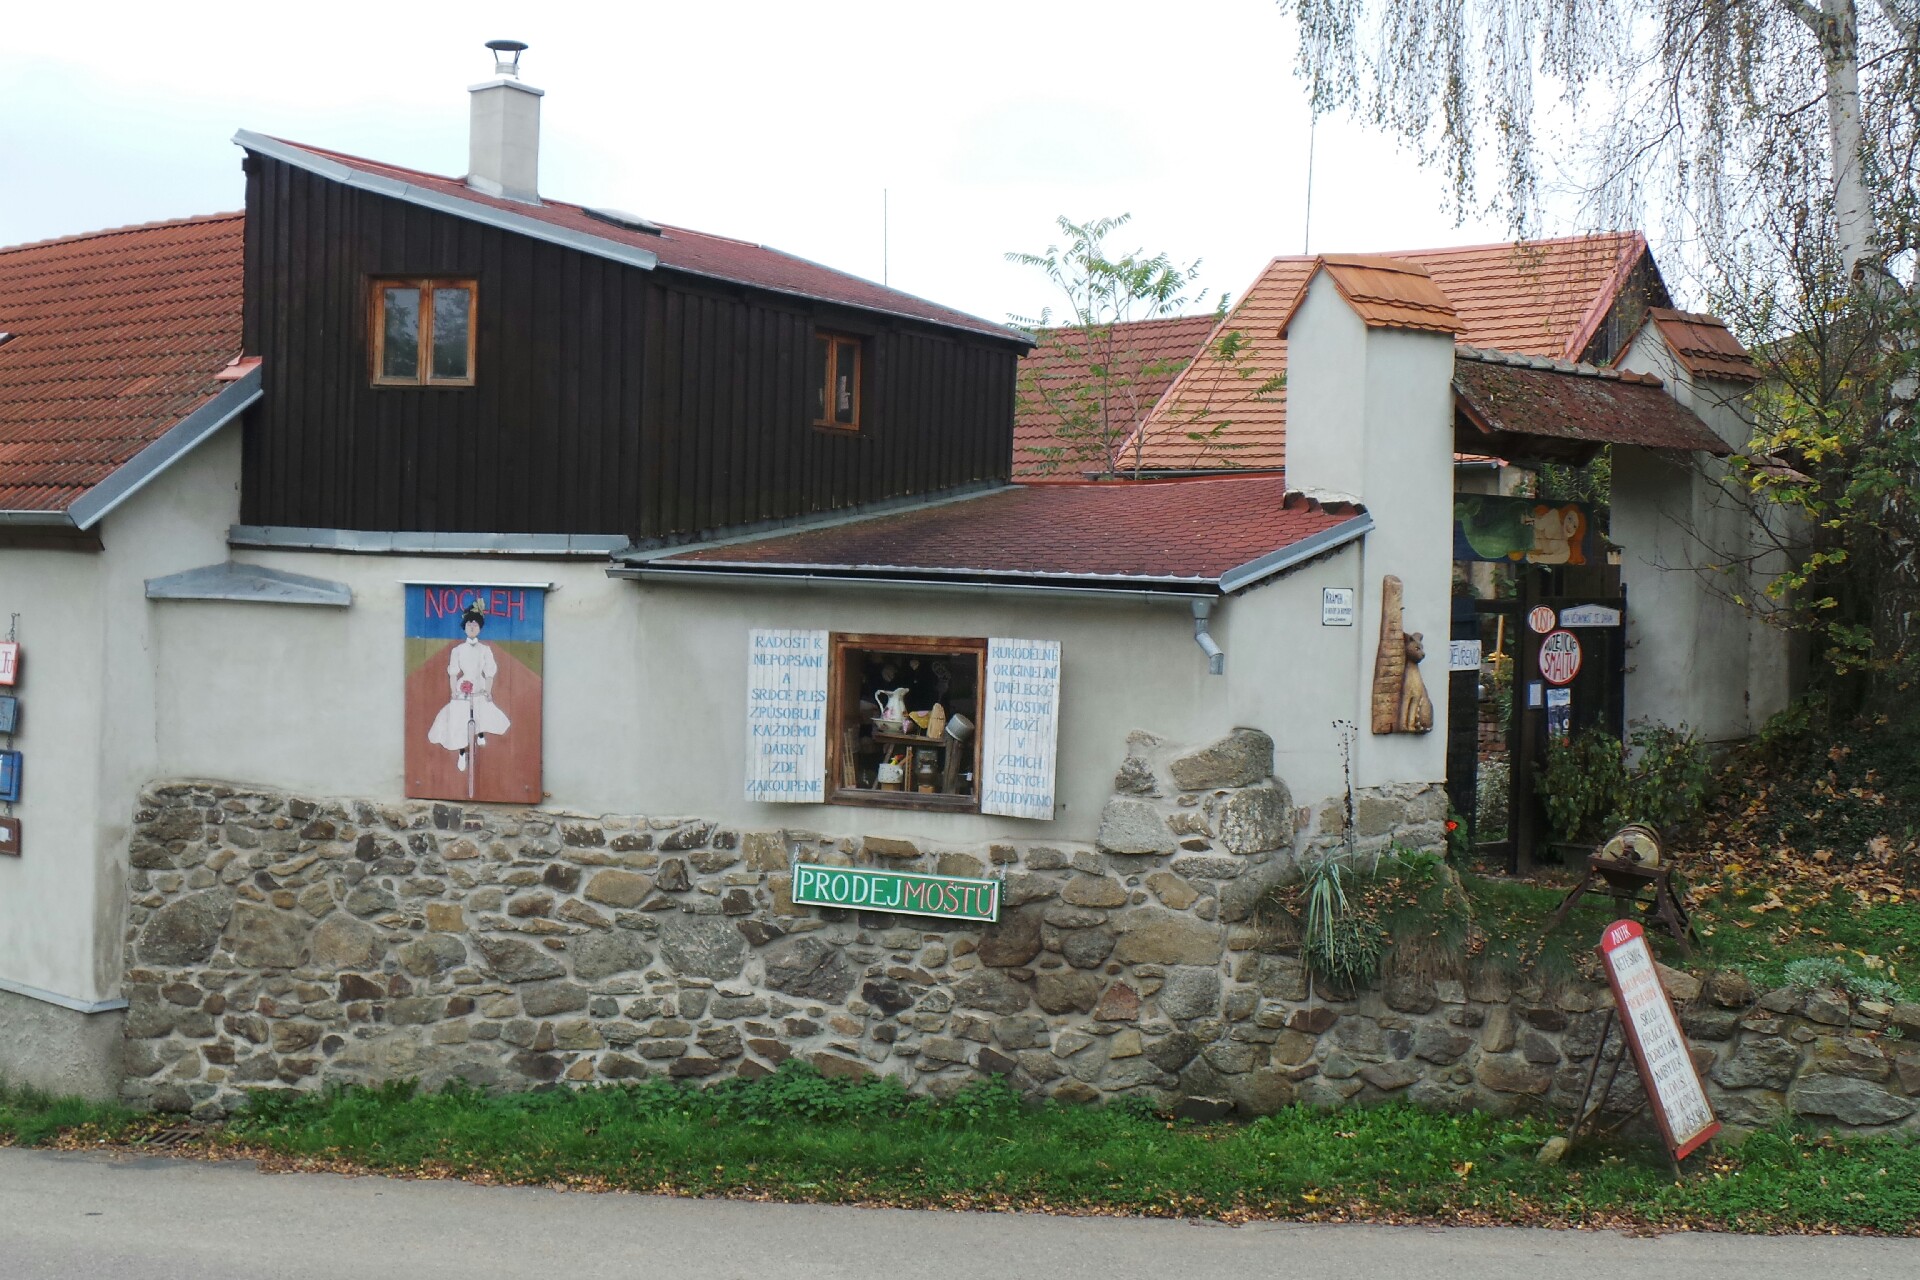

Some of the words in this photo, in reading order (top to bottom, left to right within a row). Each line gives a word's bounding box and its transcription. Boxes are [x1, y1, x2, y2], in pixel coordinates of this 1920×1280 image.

[425, 588, 525, 622] NOCLEH
[755, 636, 809, 649] RADOST
[814, 638, 822, 649] K
[754, 654, 823, 667] NEPOPSÁNÍ
[782, 673, 790, 683] A
[752, 689, 792, 701] SRDCE
[796, 691, 825, 702] PLES
[749, 704, 820, 720] ZPŮSOBUJÍ
[994, 701, 1051, 715] JAKOSTNÍ
[753, 722, 816, 737] KAŽDÉMU
[1004, 717, 1039, 731] ZBOŽÍ
[763, 741, 805, 755] DÁRKY
[1017, 737, 1024, 748] V
[771, 762, 796, 773] ZDE
[746, 779, 821, 792] ZAKOUPENÉ
[995, 772, 1045, 787] ČESKÝCH
[799, 871, 901, 906] PRODEJ
[903, 880, 995, 916] MOŠTŮ
[1611, 923, 1632, 946] ANTIK
